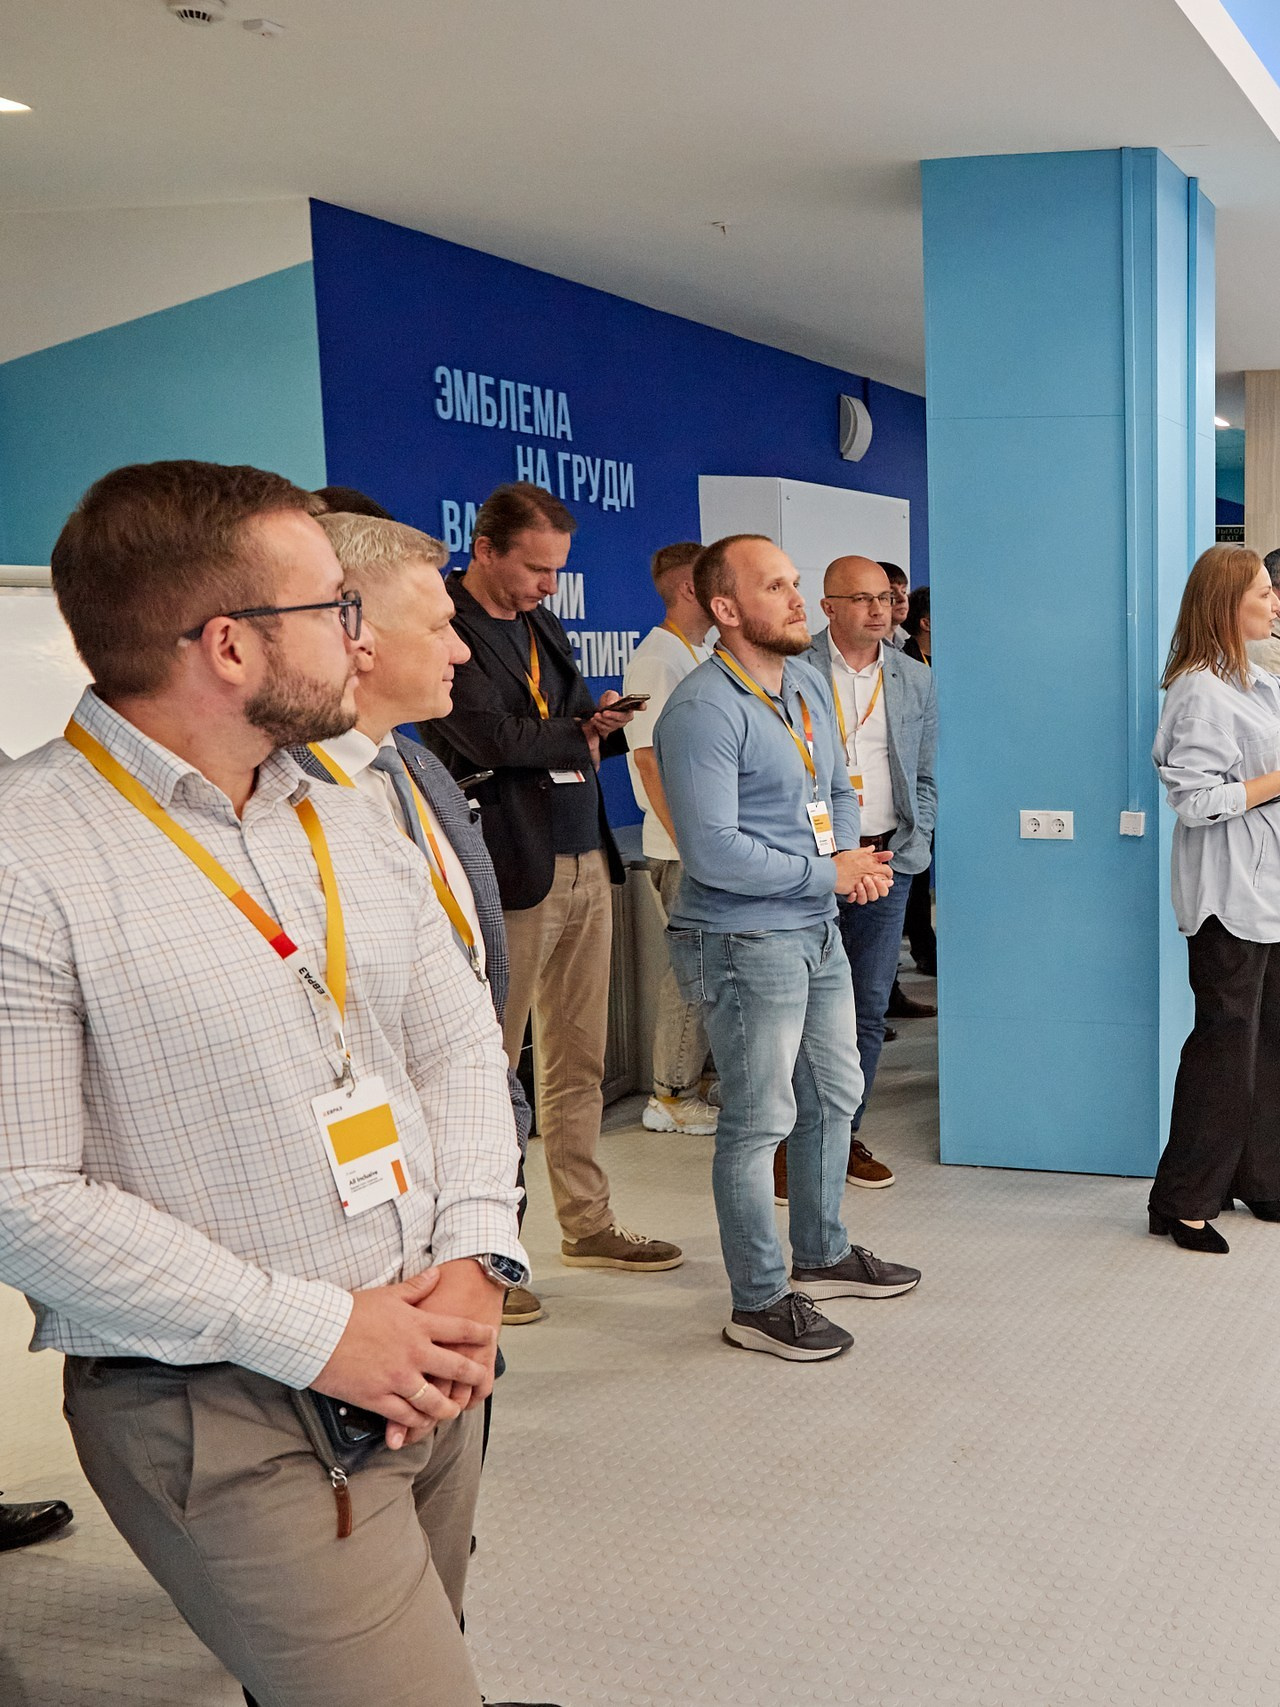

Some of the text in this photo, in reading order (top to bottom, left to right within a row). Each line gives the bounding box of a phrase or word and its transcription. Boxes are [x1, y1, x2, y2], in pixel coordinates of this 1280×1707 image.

[435, 366, 573, 441] ЭМБЛЕМА
[516, 445, 635, 512] НА ГРУДИ
